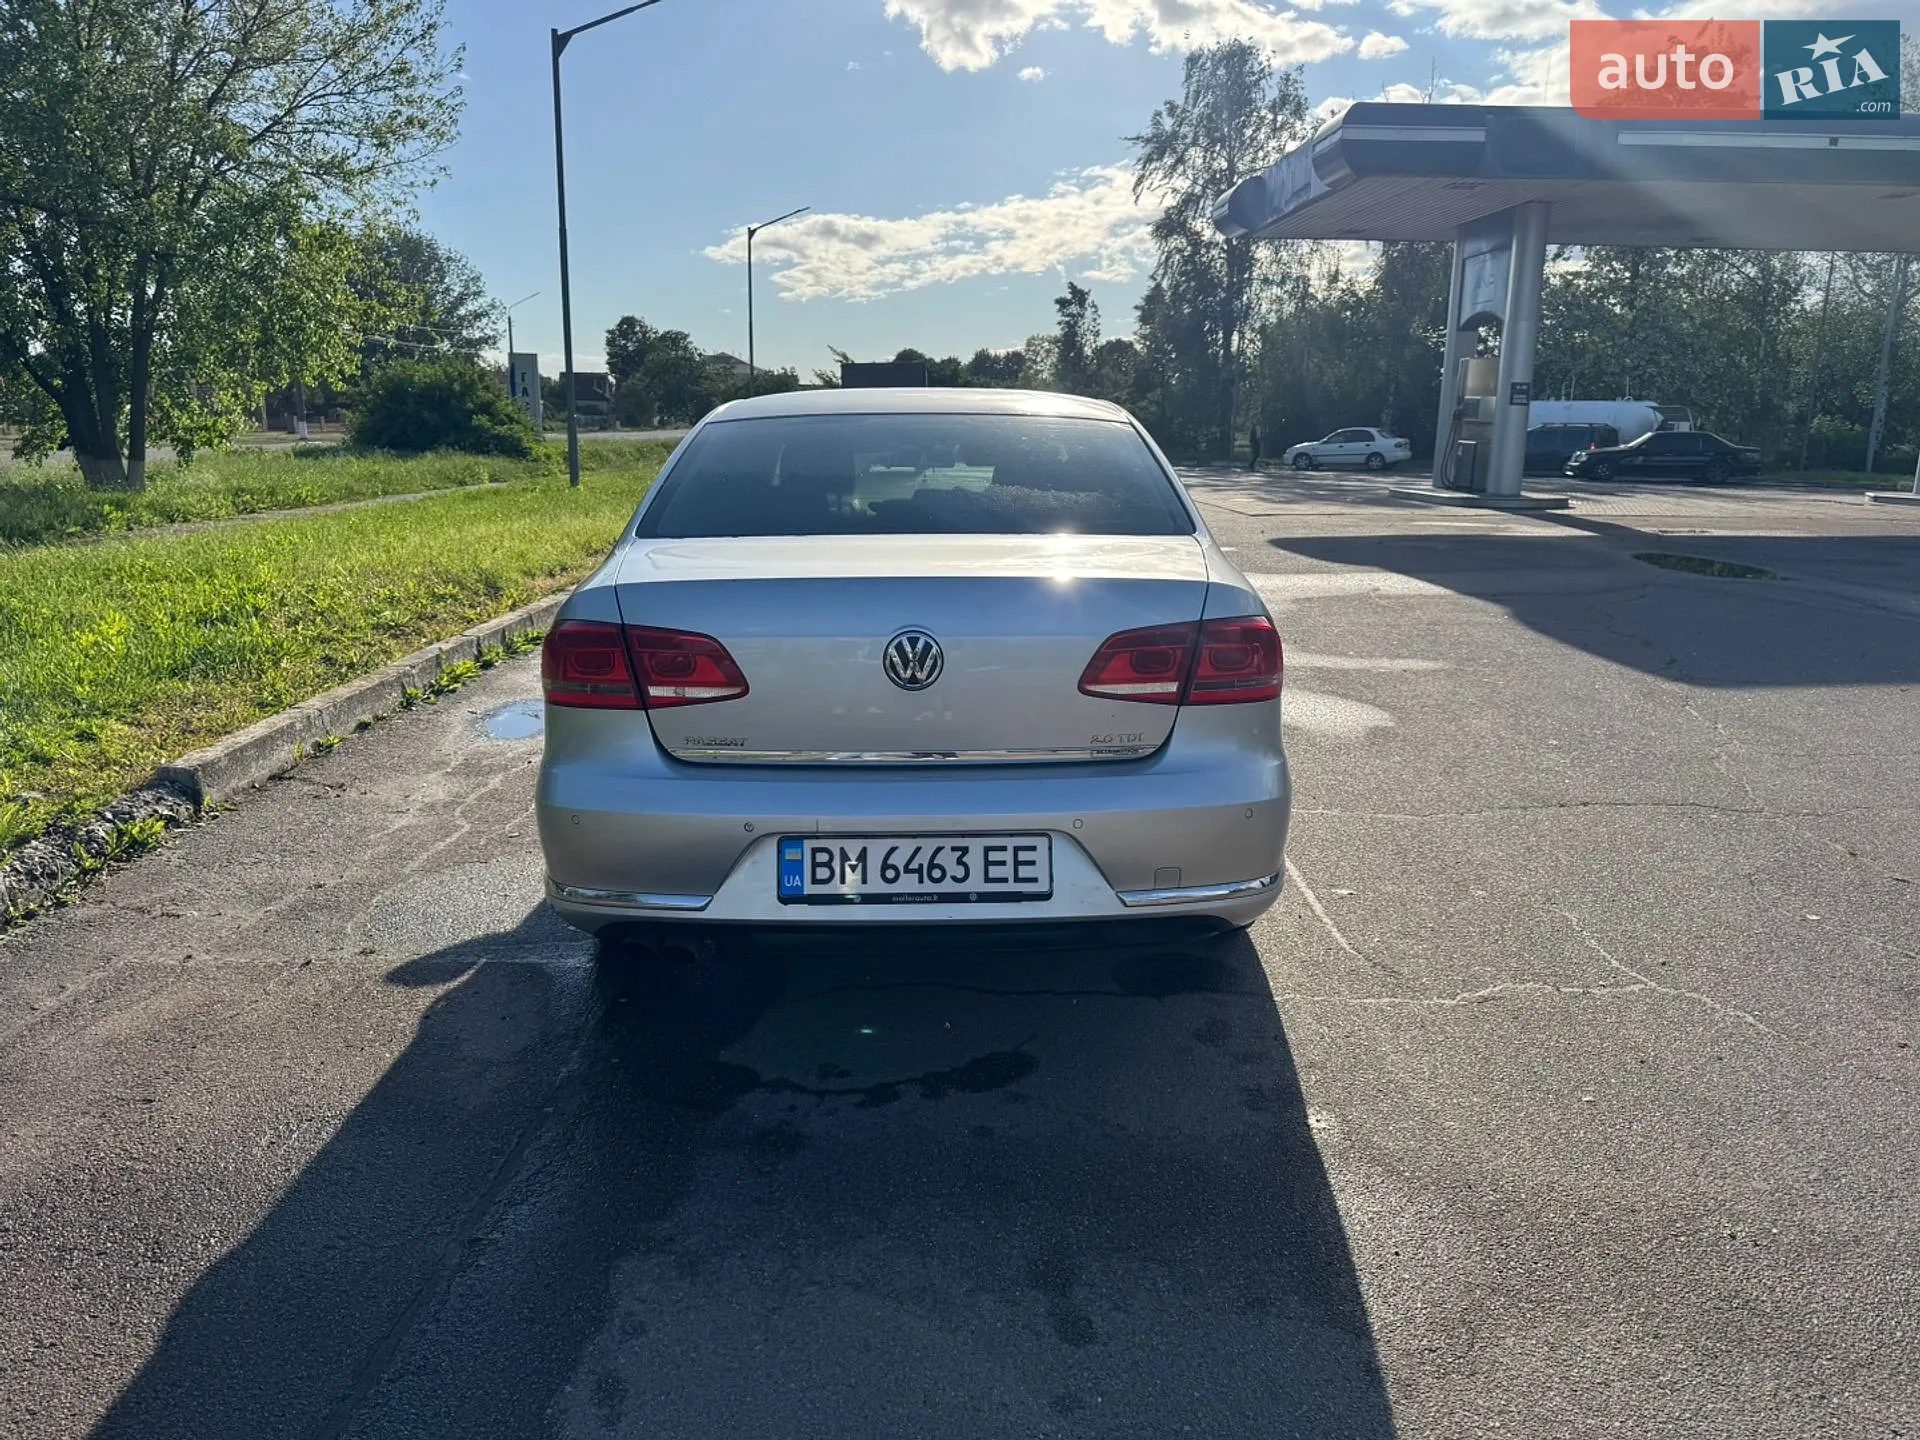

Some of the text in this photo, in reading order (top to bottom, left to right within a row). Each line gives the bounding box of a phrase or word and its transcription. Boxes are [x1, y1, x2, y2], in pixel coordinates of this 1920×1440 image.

[1117, 732, 1144, 744] TDI
[811, 845, 1039, 886] BM 6463 EE
[784, 875, 802, 888] UA
